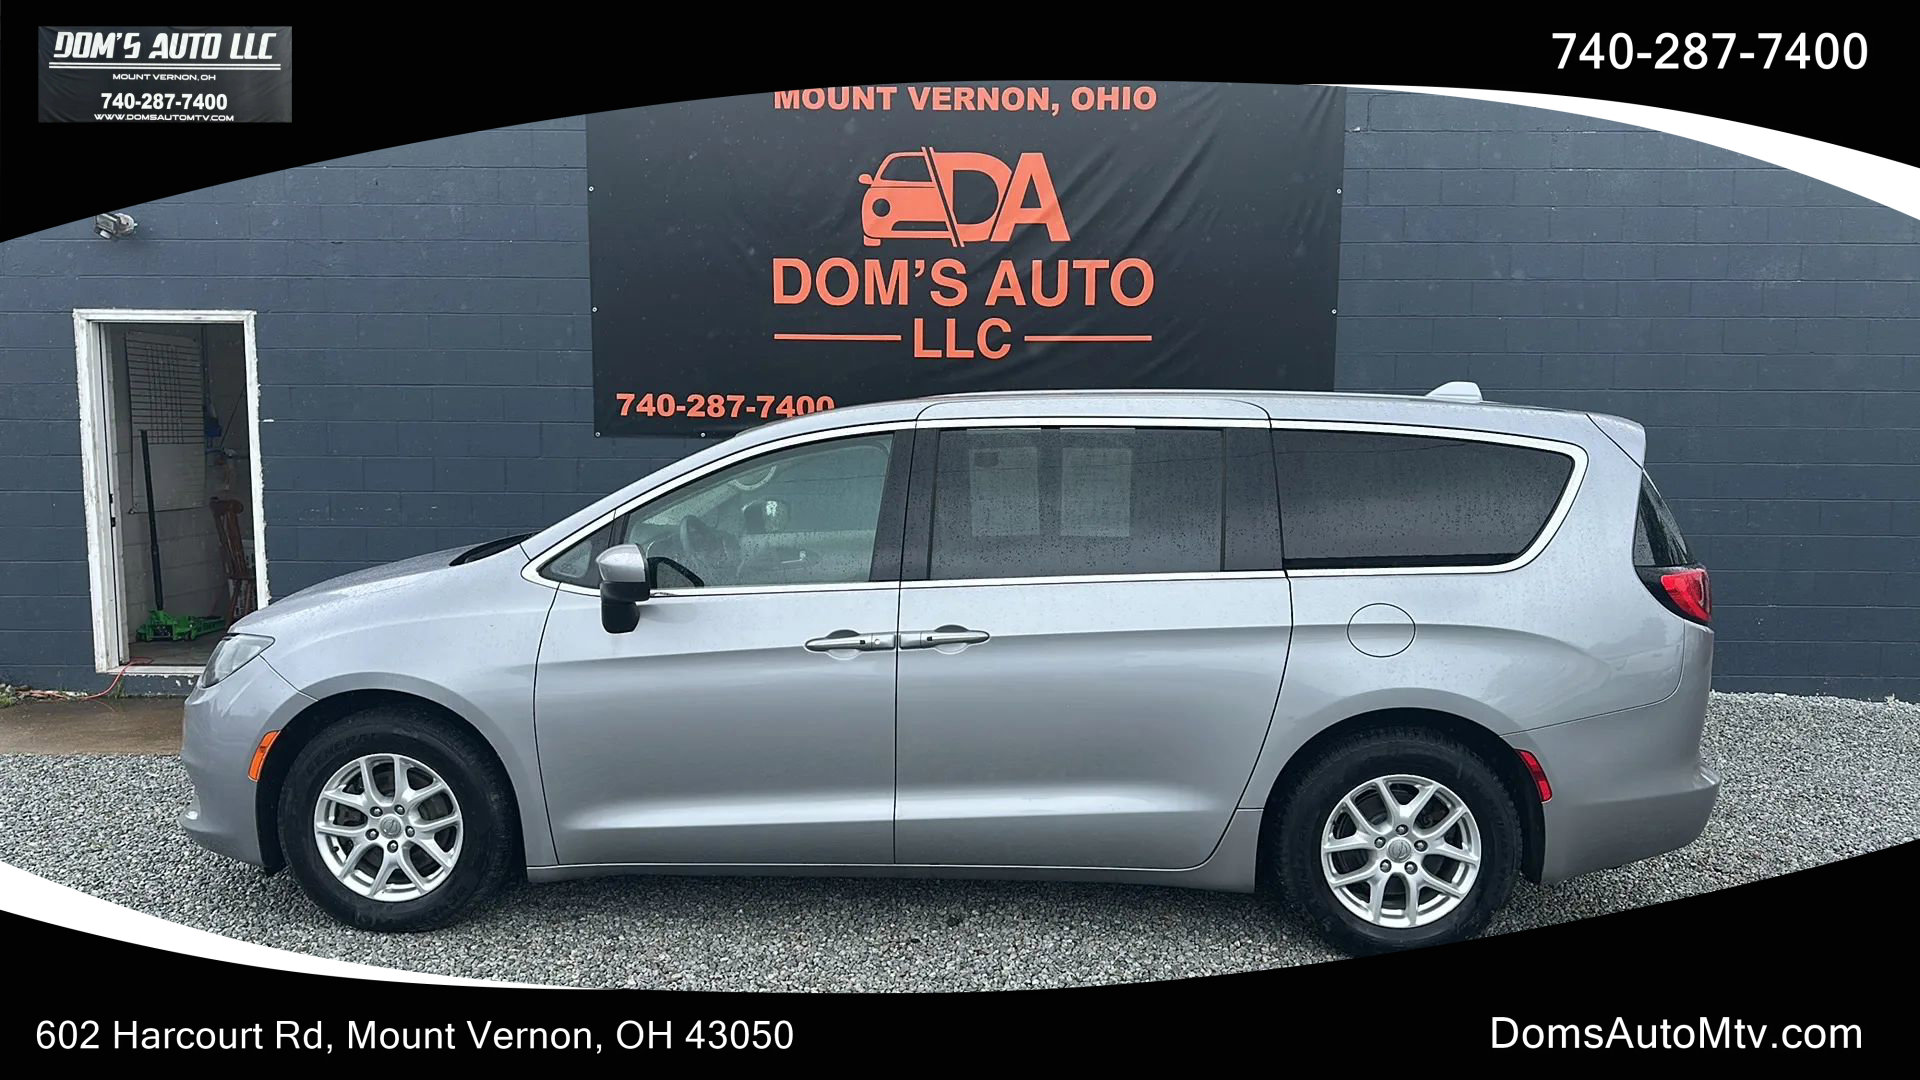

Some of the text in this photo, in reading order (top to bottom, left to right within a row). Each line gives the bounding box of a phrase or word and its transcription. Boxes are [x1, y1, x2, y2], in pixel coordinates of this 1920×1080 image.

[774, 86, 1158, 116] MOUNT VERNON, OHIO
[986, 257, 1155, 307] AUTO
[912, 318, 1013, 359] LLC
